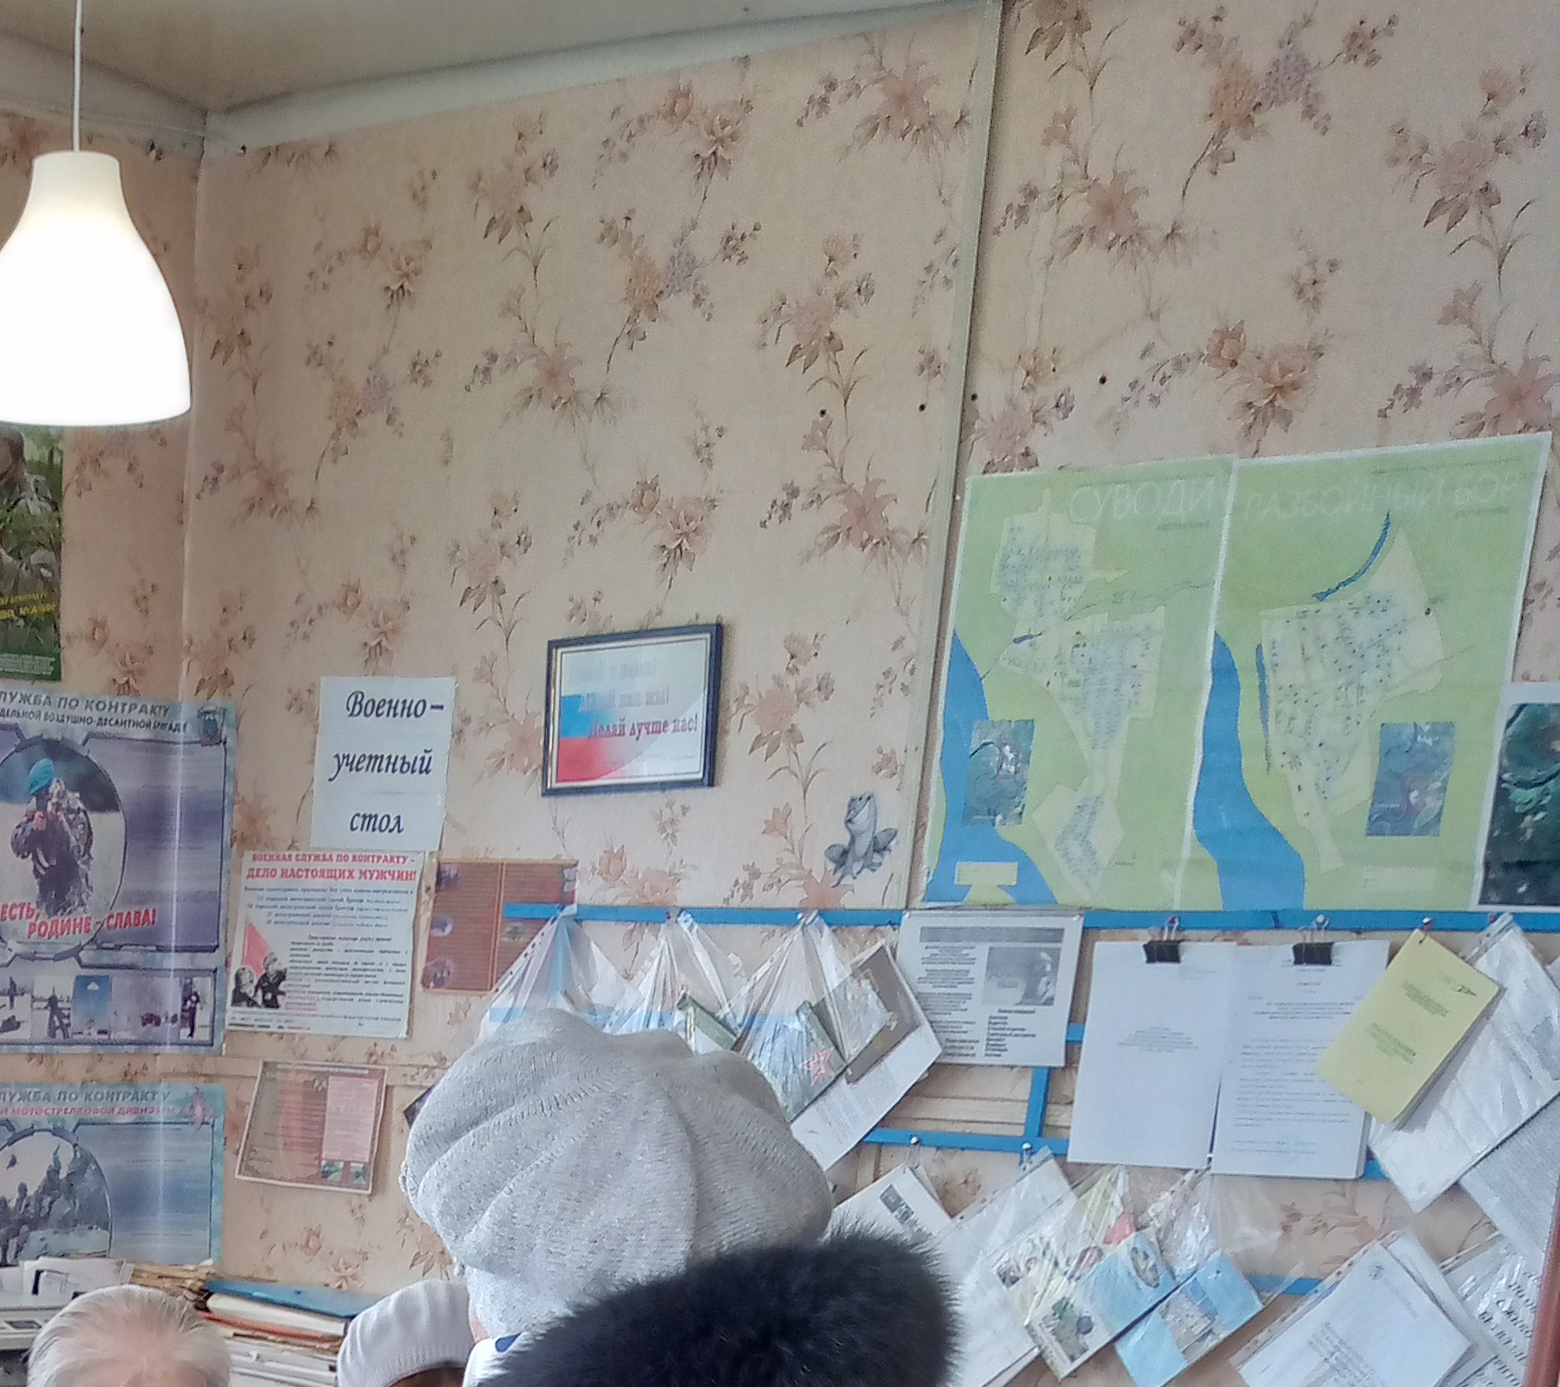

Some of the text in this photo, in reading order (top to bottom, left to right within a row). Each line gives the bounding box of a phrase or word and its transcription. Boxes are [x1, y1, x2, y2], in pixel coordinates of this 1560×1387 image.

[57, 696, 80, 710] ПО
[85, 699, 171, 717] КОНТРАКТУ
[629, 718, 669, 742] лучше
[672, 712, 698, 734] нас!
[328, 748, 433, 782] учетный
[350, 812, 404, 834] стол
[252, 853, 293, 863] ВОЕННАЯ
[295, 853, 334, 863] СЛУЖБА
[336, 853, 349, 863] ПО
[352, 854, 408, 865] КОНТРАКТУ
[246, 868, 417, 882] ДЕЛО НАСТОЯЩИХ МУЖЧИН!
[27, 916, 93, 939] РОДИНЕ
[105, 907, 157, 930] СЛАВА!
[57, 1090, 79, 1103] ПО
